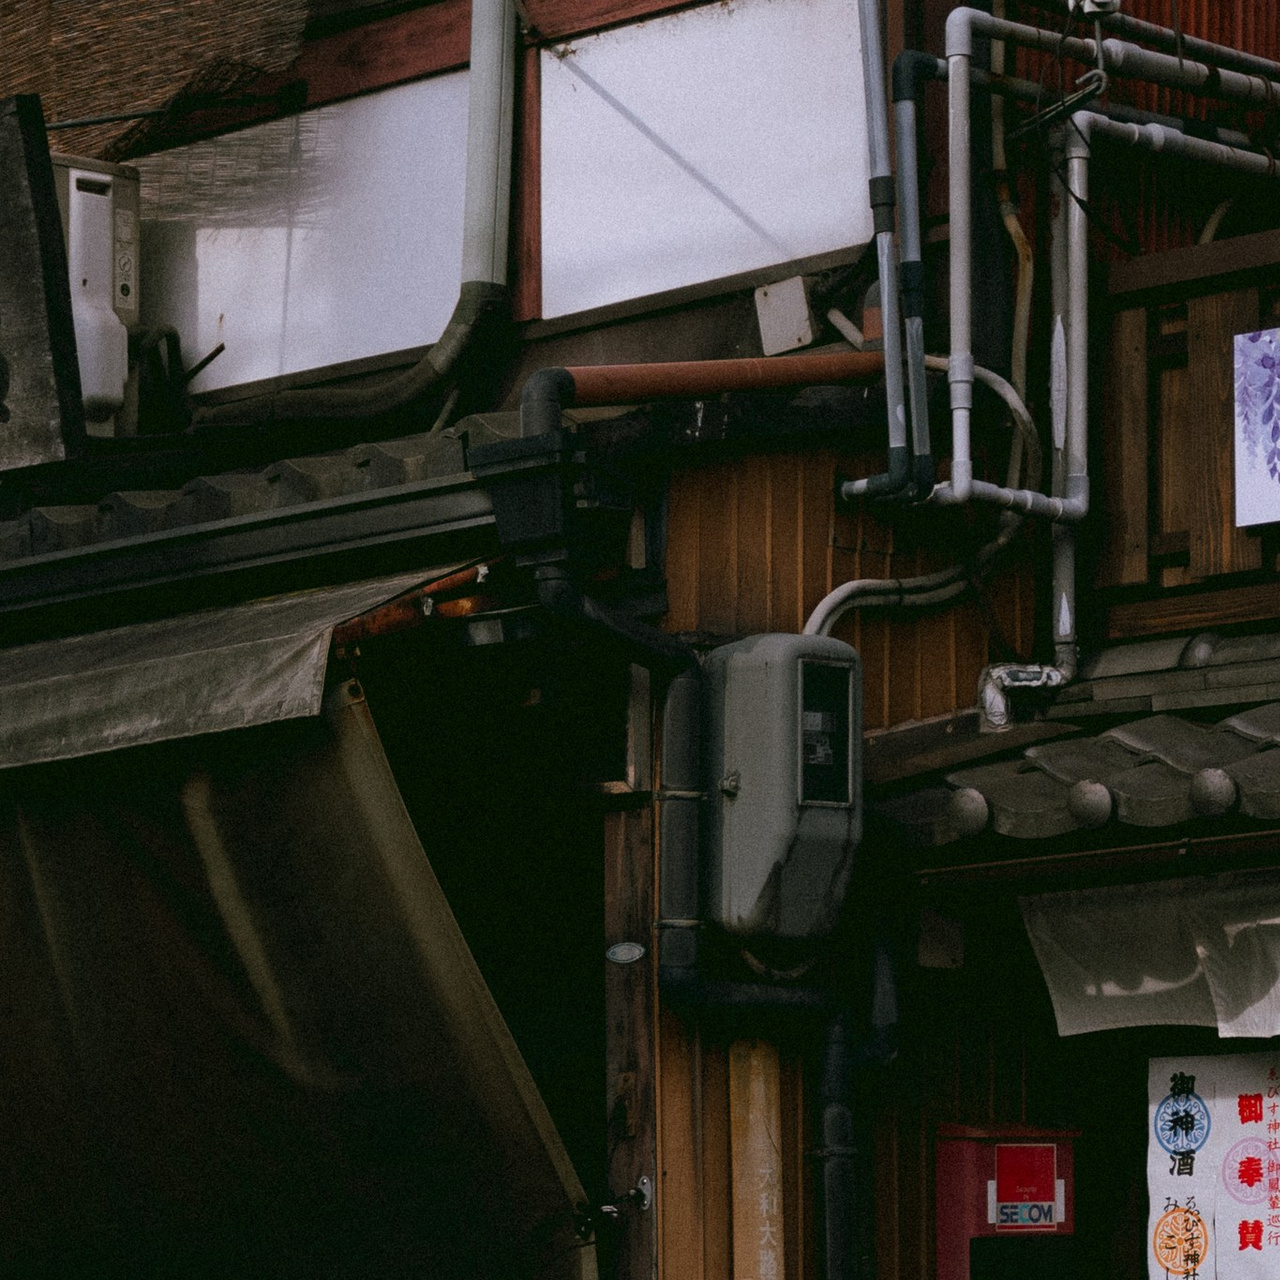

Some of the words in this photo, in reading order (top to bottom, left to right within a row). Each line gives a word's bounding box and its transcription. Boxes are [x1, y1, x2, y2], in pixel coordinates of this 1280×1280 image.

[1170, 1071, 1196, 1177] 御神酒
[1238, 1093, 1264, 1252] 御奉賛
[1000, 1203, 1053, 1223] SECOM
